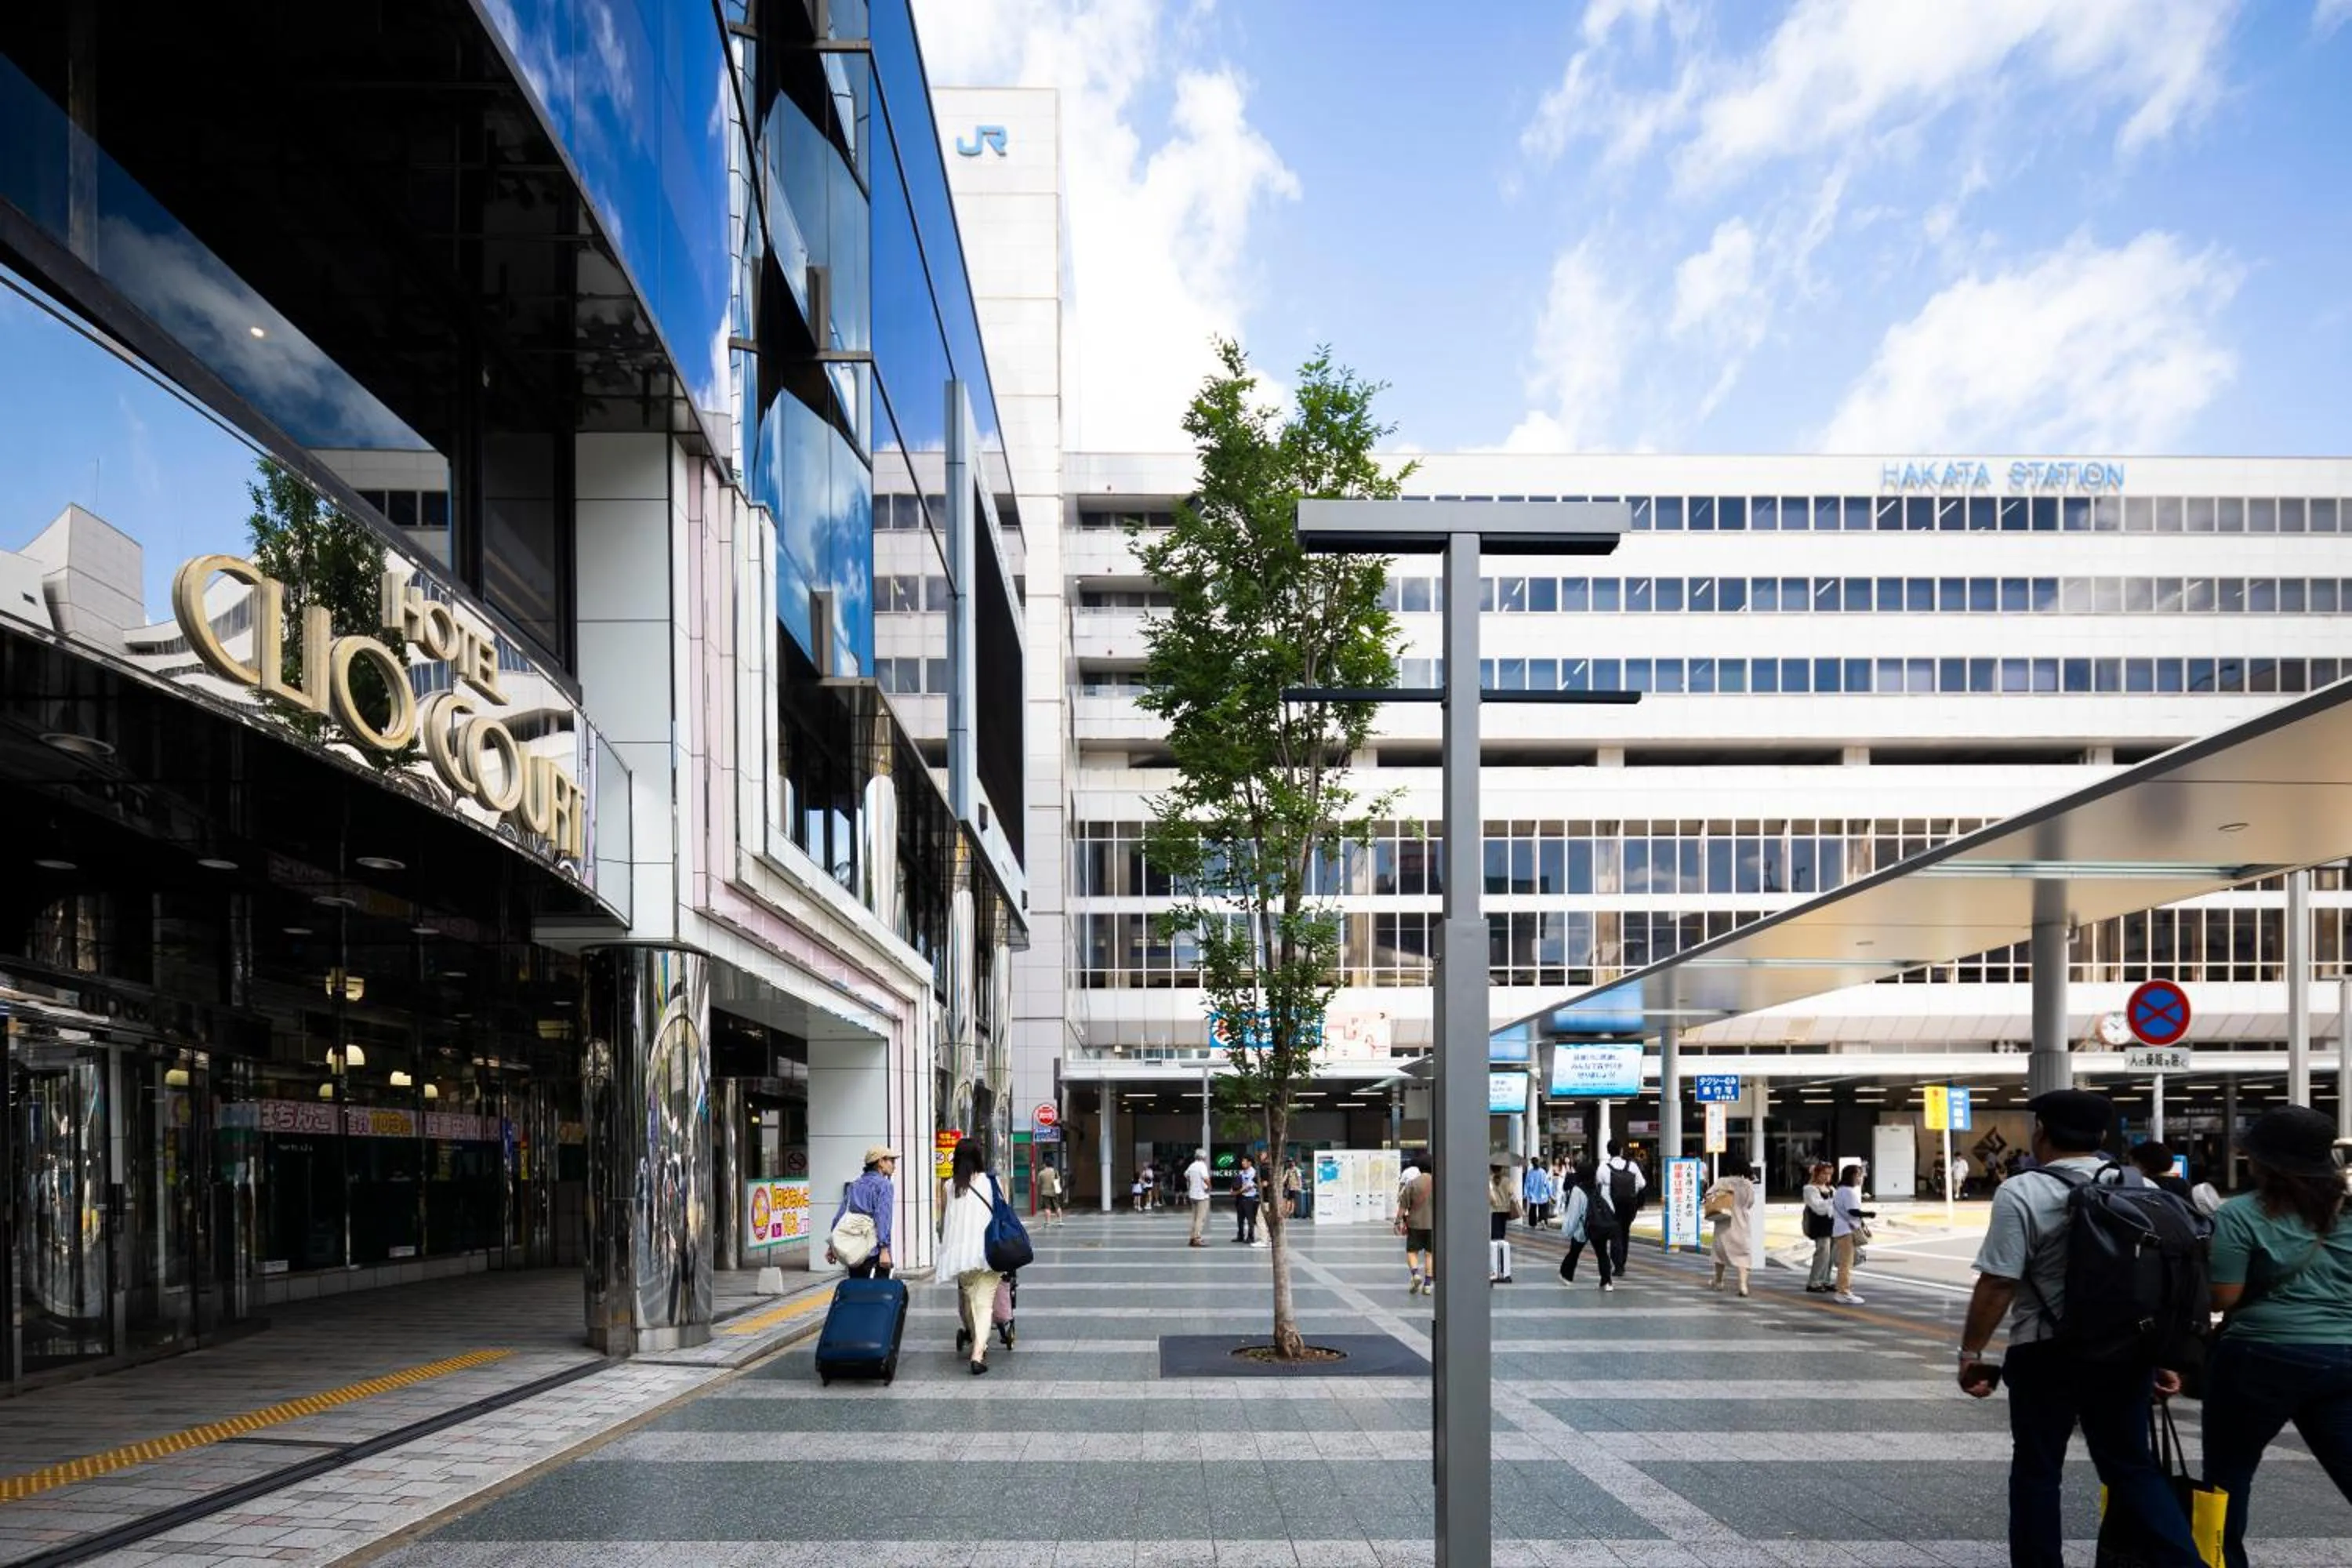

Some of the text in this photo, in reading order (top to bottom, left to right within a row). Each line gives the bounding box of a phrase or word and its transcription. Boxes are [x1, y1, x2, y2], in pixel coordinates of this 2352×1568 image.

[956, 125, 1007, 157] JR
[1881, 461, 2125, 488] HAKATA STATION
[382, 571, 510, 706] HOTEL
[172, 554, 585, 859] CLIO COURT
